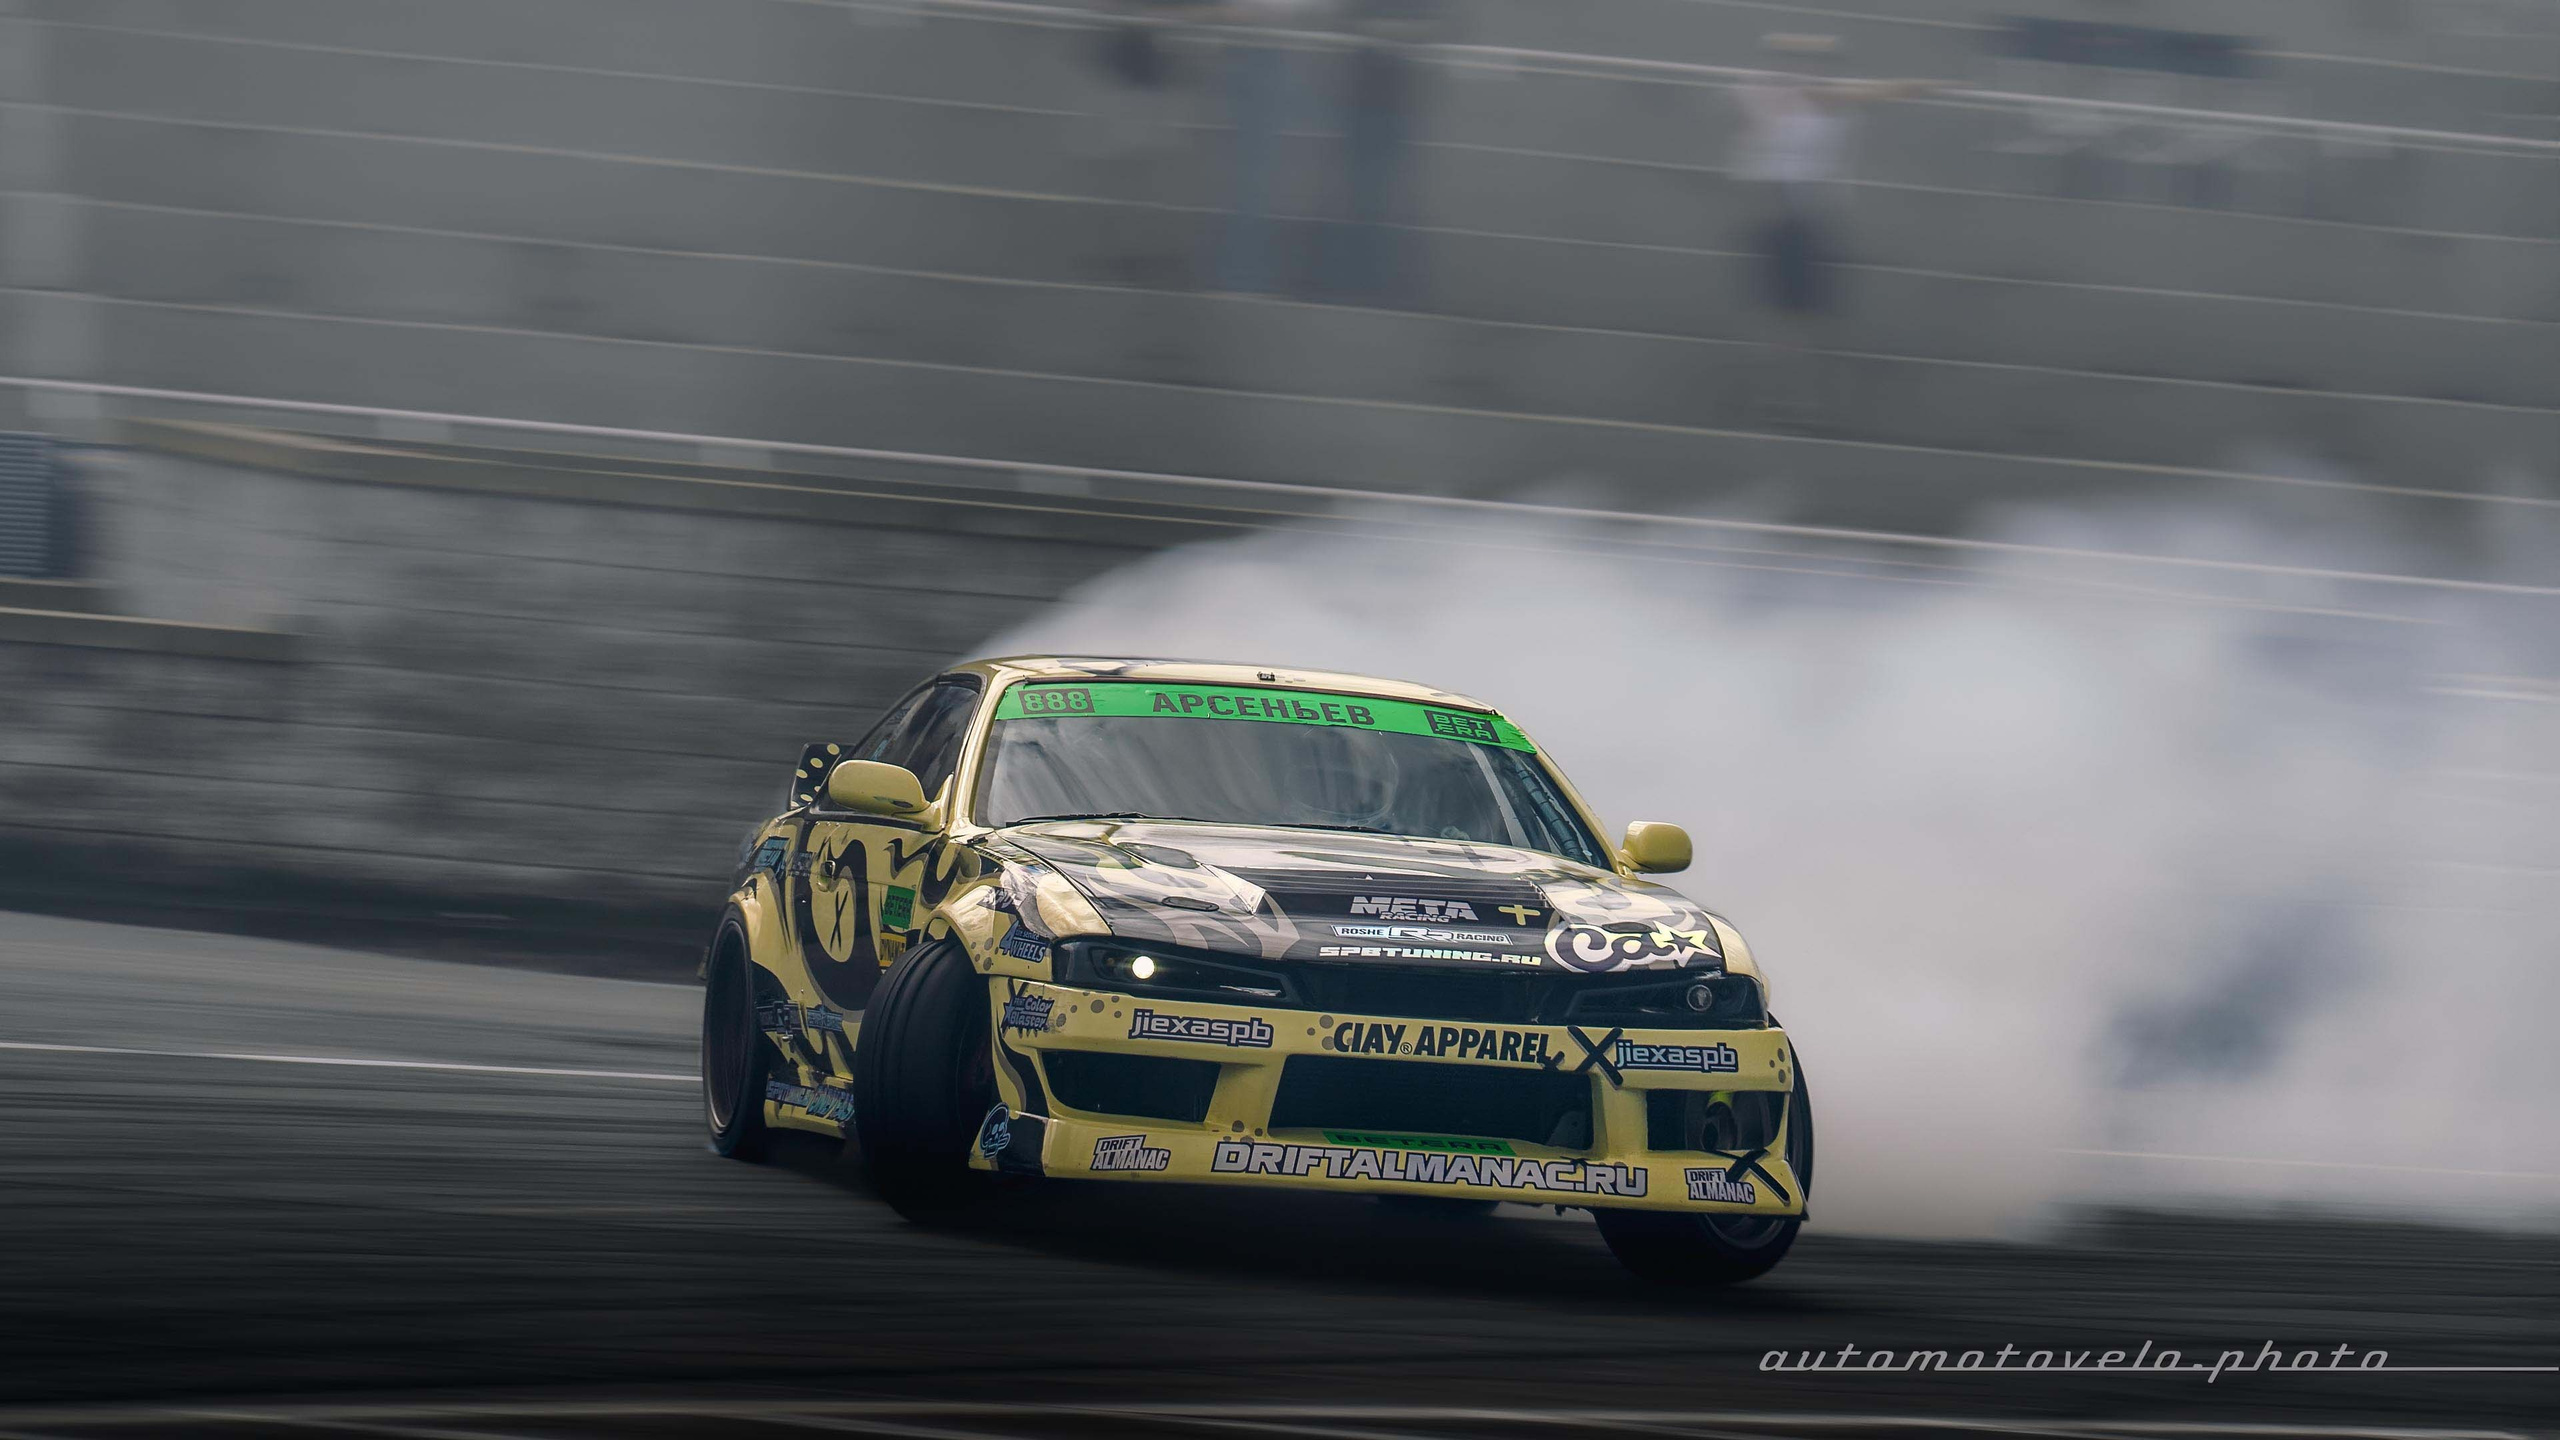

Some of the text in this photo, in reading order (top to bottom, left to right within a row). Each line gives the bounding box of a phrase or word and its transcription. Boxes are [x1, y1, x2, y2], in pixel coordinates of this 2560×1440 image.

[1023, 691, 1089, 712] 888
[1152, 692, 1375, 726] АРСЕНЬЕВ
[1350, 896, 1479, 921] META
[1380, 911, 1451, 923] RACING
[1341, 927, 1385, 936] ROSHE
[1456, 933, 1505, 942] RACING
[1011, 940, 1046, 962] WHEELS
[1319, 946, 1542, 967] SPBTUNING.RU
[1025, 997, 1052, 1013] Color
[1010, 1011, 1047, 1028] Blaster
[1131, 1011, 1272, 1044] jiexaspb
[1412, 1025, 1552, 1064] APPAREL
[1616, 1041, 1737, 1070] jiexaspb
[1101, 1138, 1141, 1151] DRIFT
[1335, 1134, 1503, 1152] BETERA
[1092, 1149, 1170, 1170] ALMANAC
[1213, 1142, 1647, 1197] DRIFTALMANAC.RU
[1690, 1170, 1722, 1182] DRIFT
[1690, 1181, 1755, 1204] ALMANAC
